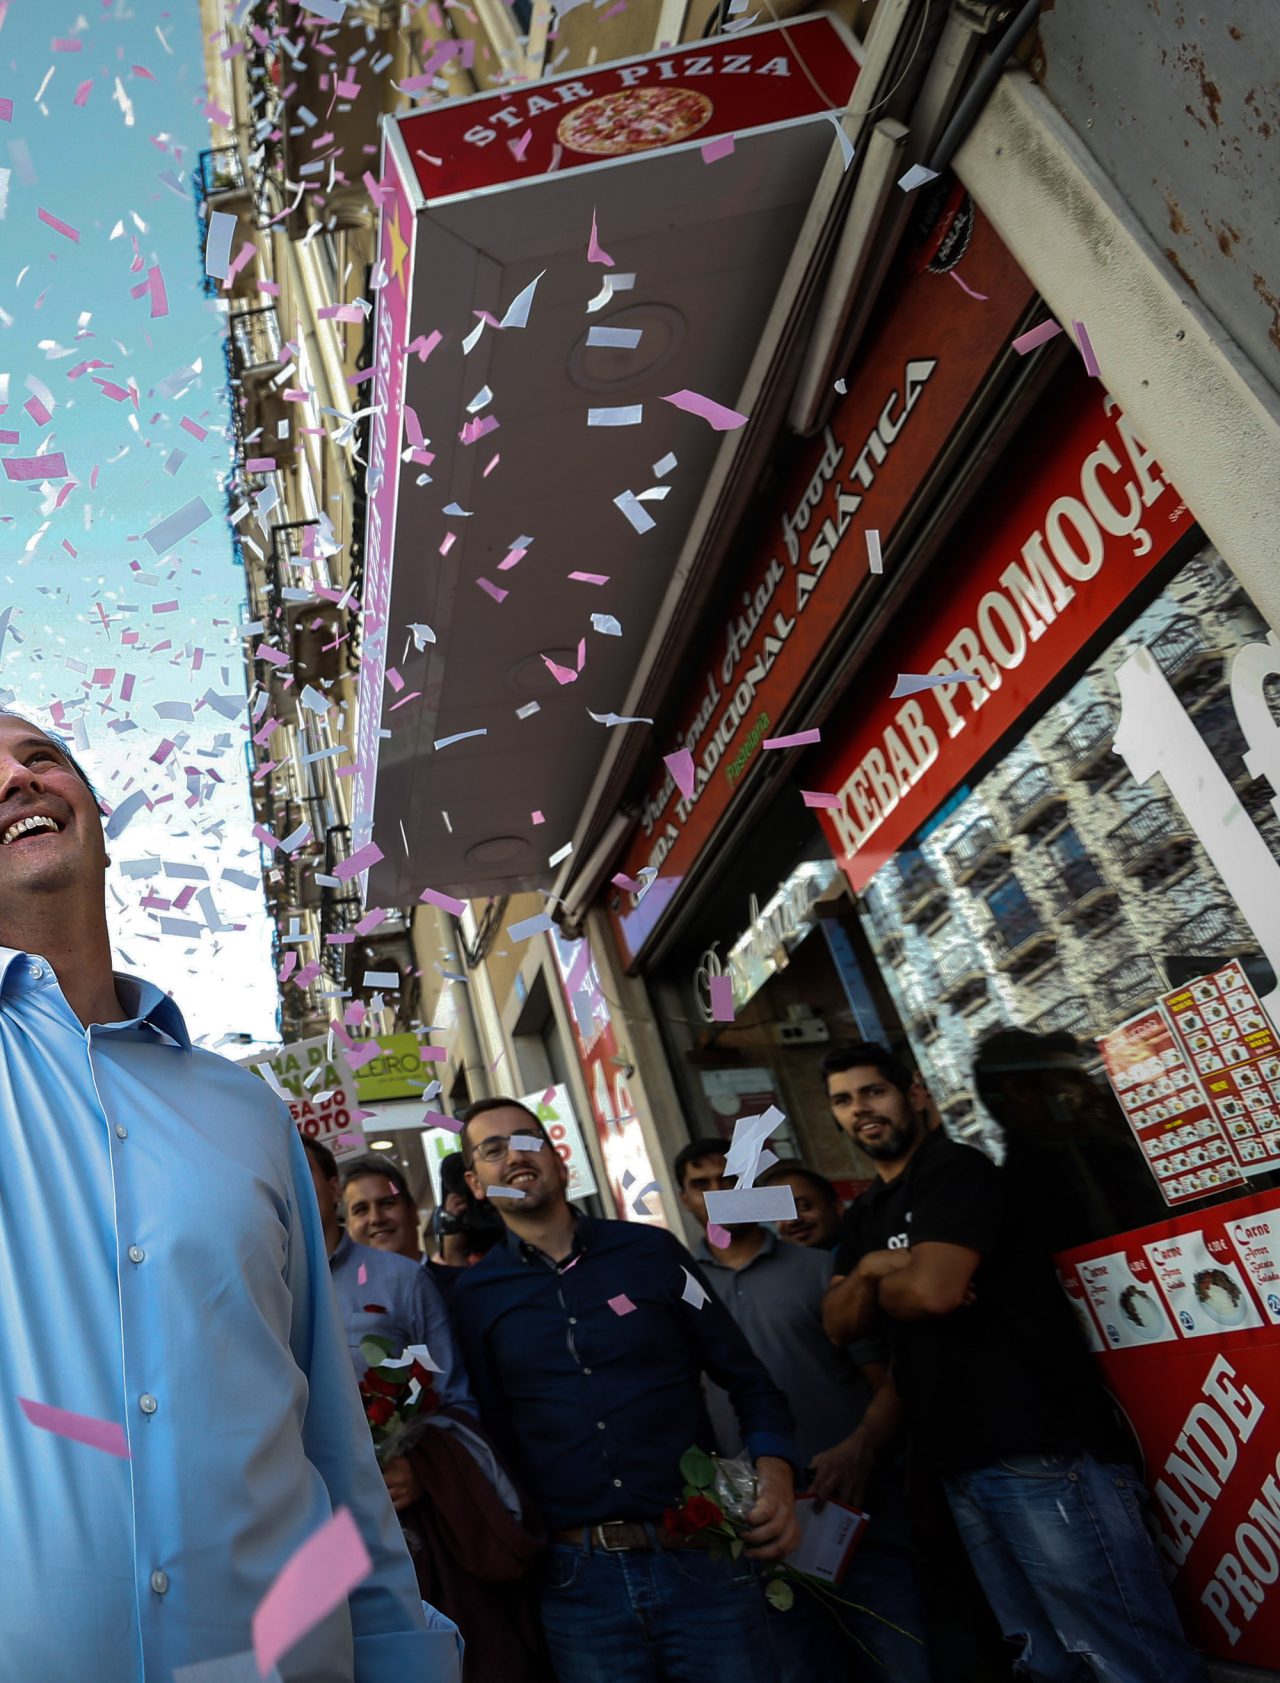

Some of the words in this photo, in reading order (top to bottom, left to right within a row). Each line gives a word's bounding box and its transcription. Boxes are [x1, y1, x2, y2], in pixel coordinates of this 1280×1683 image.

[463, 80, 593, 147] STAR
[616, 54, 792, 88] PIZZA
[642, 672, 721, 837] Tradonal
[722, 558, 784, 685] Asian
[782, 424, 844, 565] food
[825, 699, 940, 861] KEBAB
[927, 393, 1172, 739] PROMOÇÃ
[1151, 1246, 1183, 1267] Carne
[1234, 1223, 1271, 1246] Carne
[1146, 1353, 1265, 1580] RANDE
[1201, 1452, 1280, 1647] PROM
